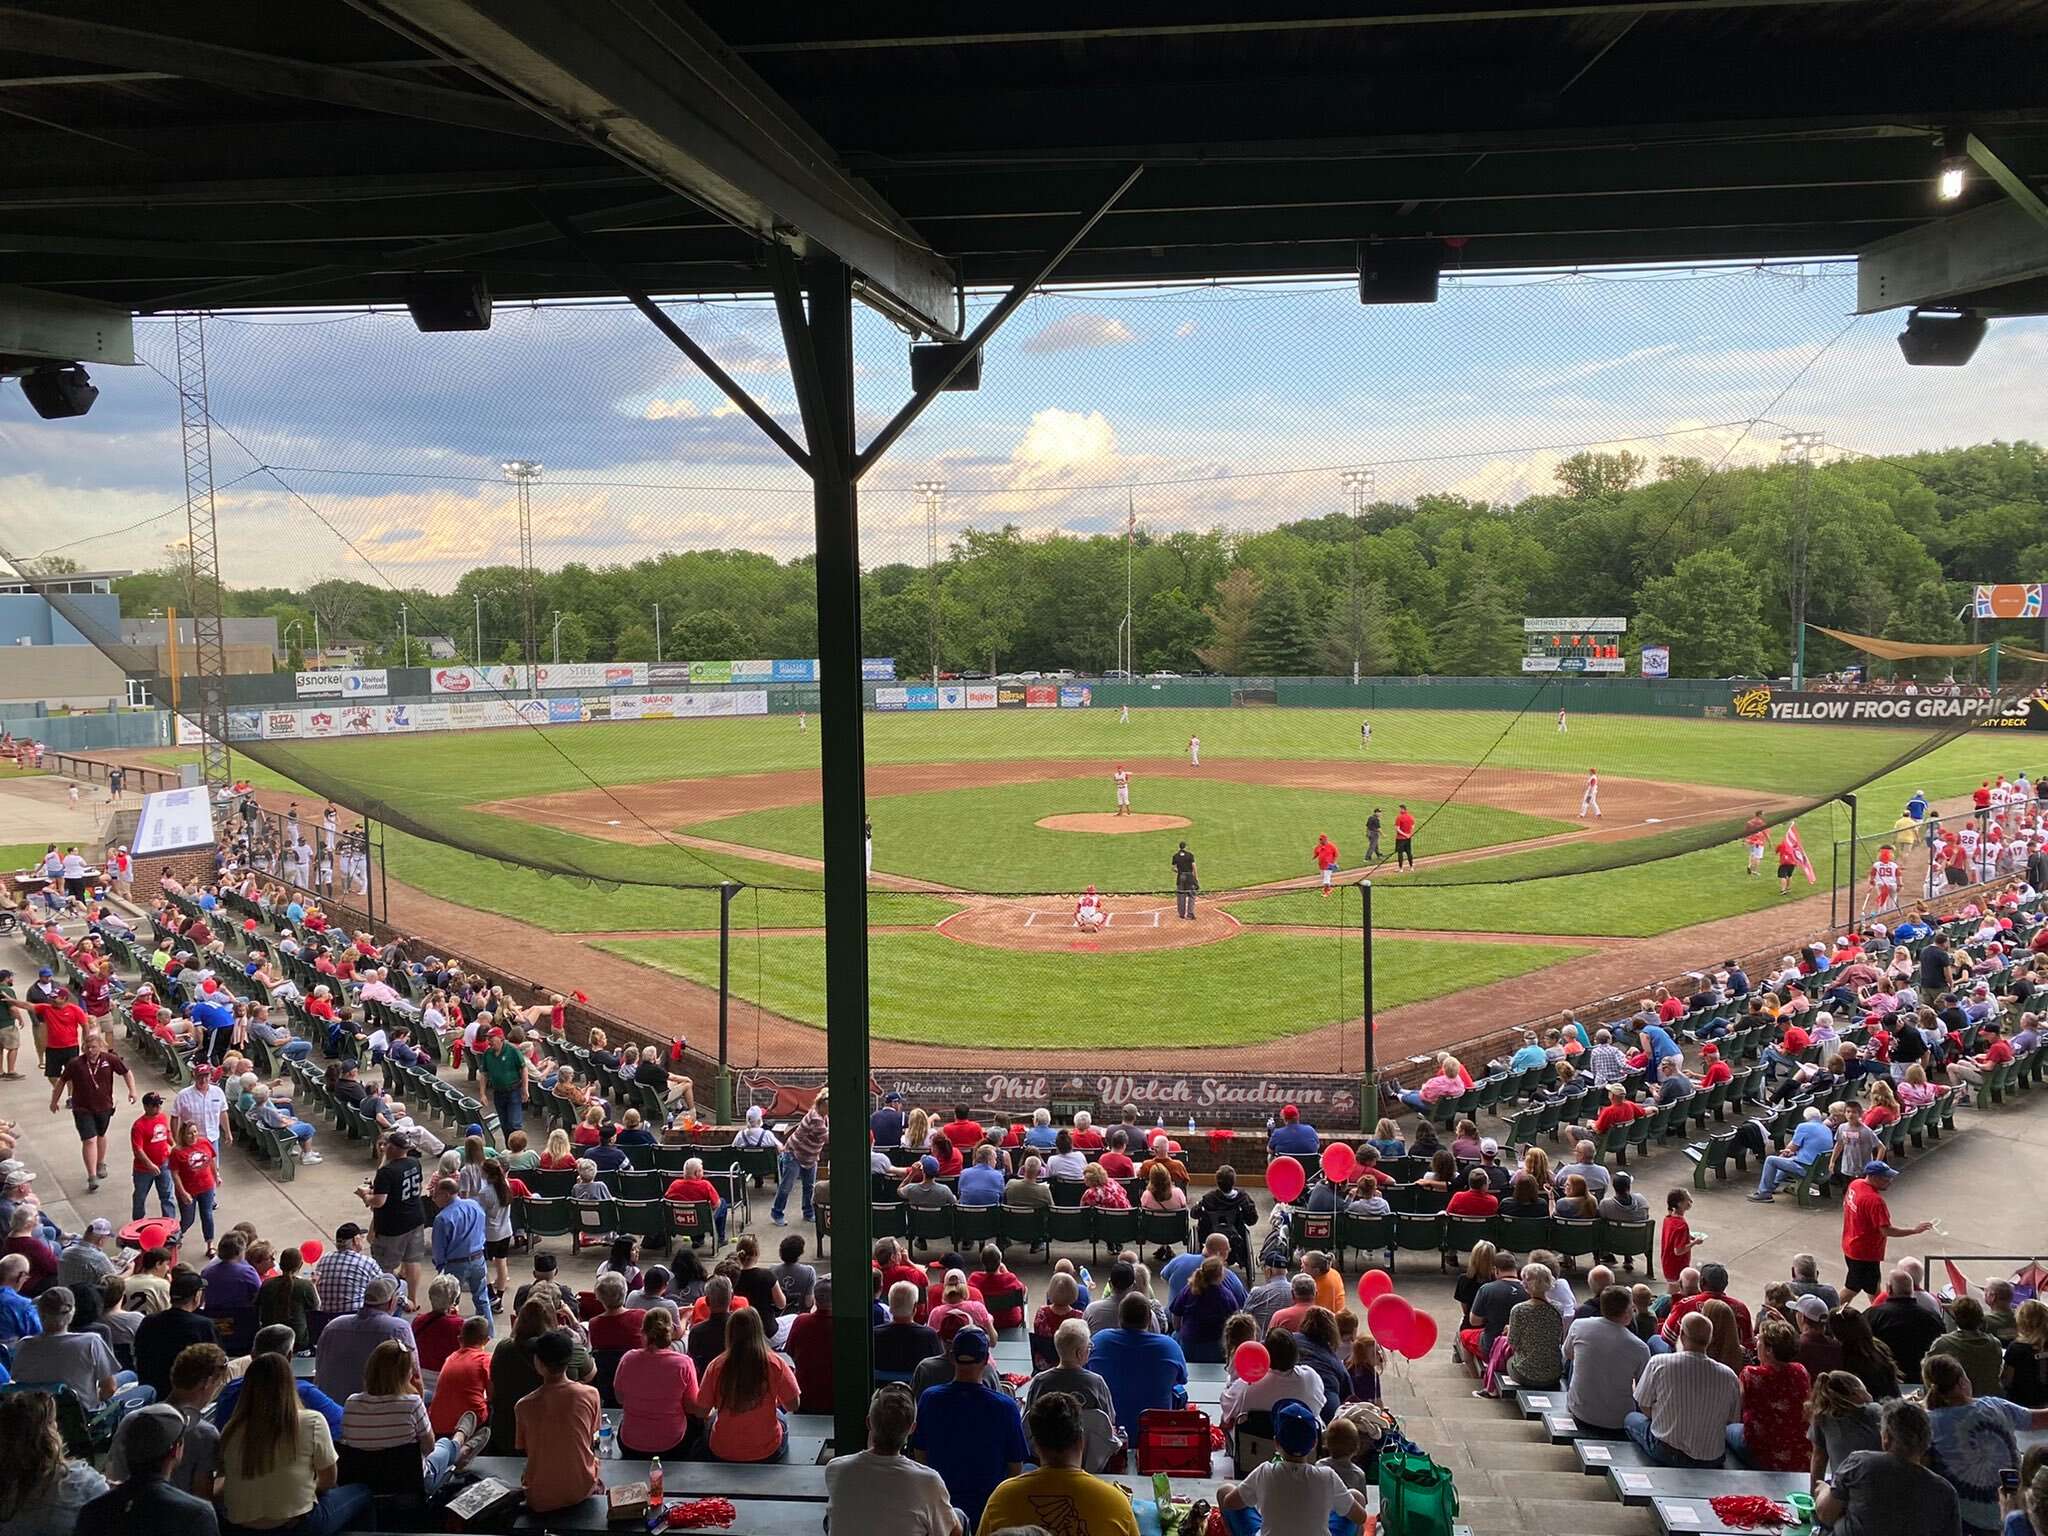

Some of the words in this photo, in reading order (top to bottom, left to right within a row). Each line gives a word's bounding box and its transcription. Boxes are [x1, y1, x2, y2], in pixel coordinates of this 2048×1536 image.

[305, 675, 343, 686] snorkel
[362, 682, 388, 690] Rentals
[641, 695, 672, 705] SAV-ON
[1771, 701, 1849, 719] YELLOW
[1852, 700, 1911, 718] FROG
[1915, 697, 2032, 717] GRAPHICS
[270, 714, 296, 724] PIZZA
[2001, 718, 2028, 727] DECK
[893, 1081, 952, 1095] Welcome
[961, 1085, 973, 1094] to
[983, 1074, 1047, 1103] Phil
[1097, 1076, 1192, 1105] Welch
[1197, 1078, 1325, 1107] Stadium
[402, 1174, 421, 1200] 25
[686, 1215, 695, 1223] H
[1309, 1226, 1316, 1235] F
